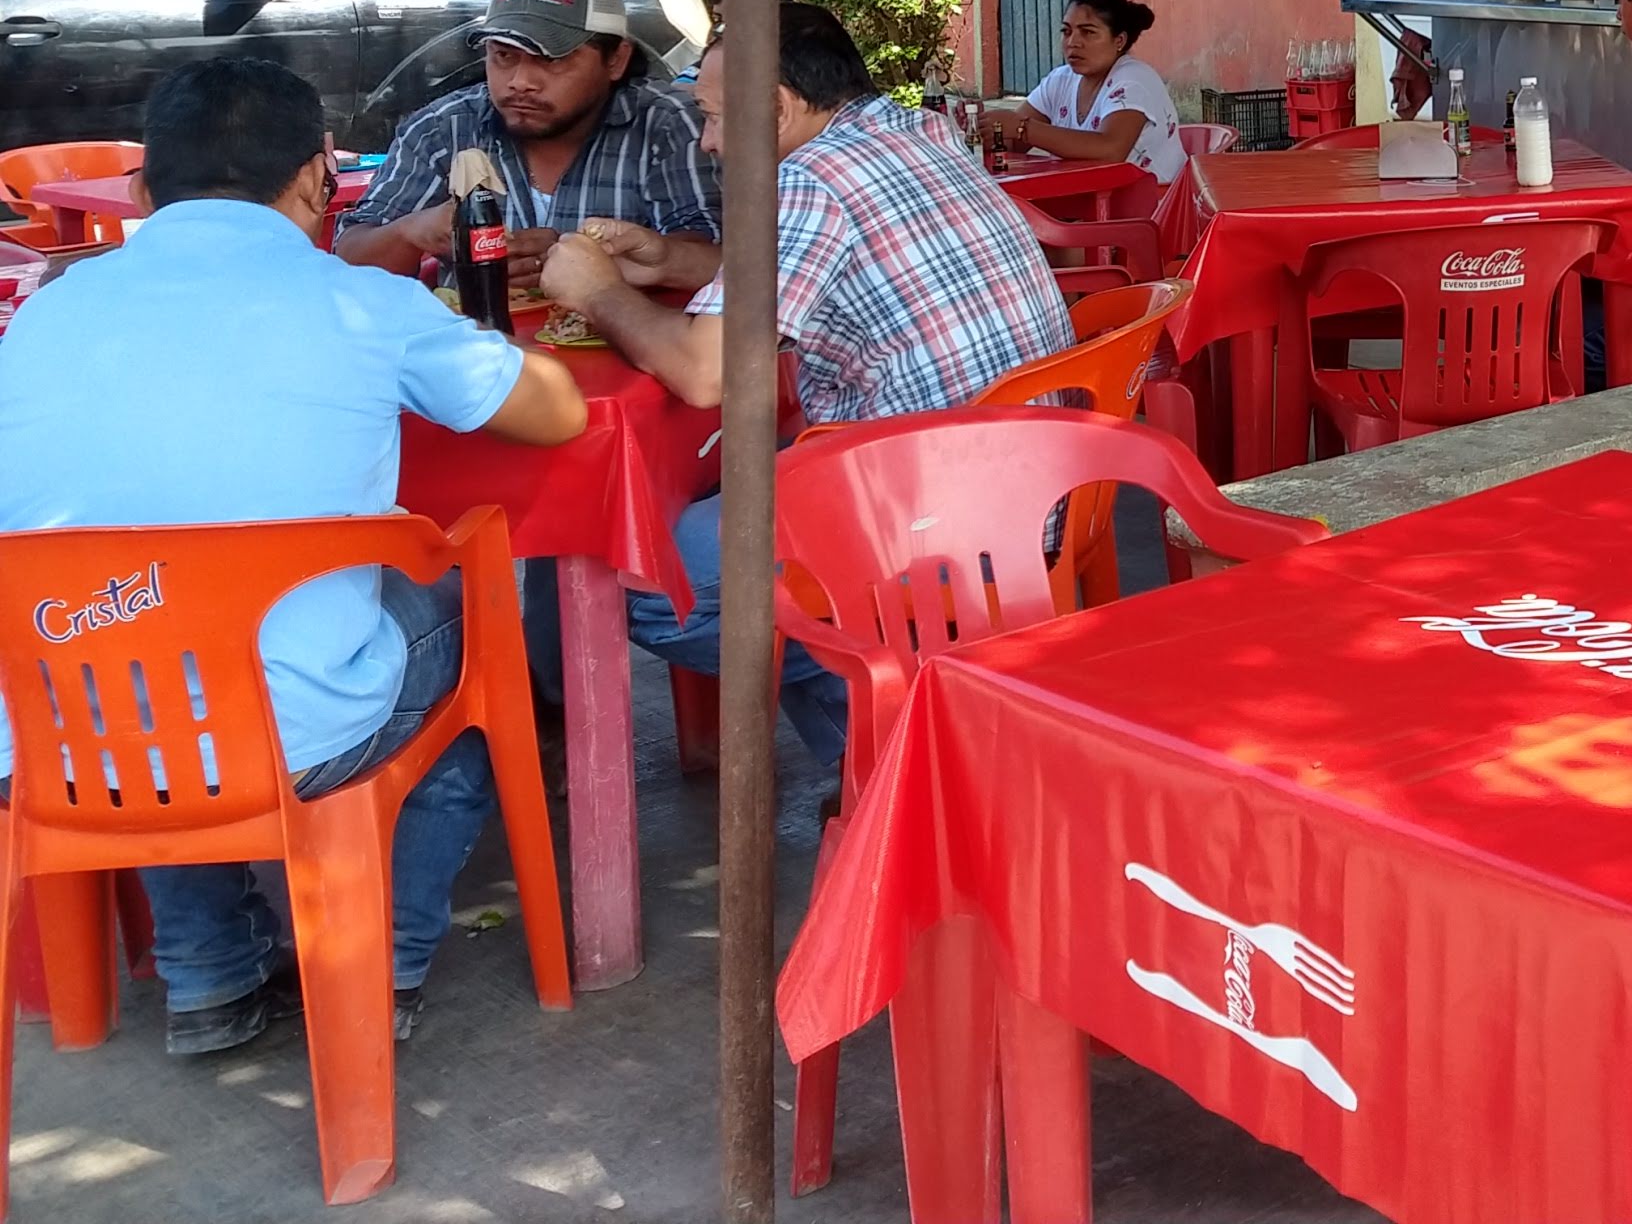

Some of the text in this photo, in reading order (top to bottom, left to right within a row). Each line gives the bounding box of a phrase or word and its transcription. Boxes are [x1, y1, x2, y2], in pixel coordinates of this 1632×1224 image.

[1441, 248, 1526, 276] Coca-Cola
[1443, 276, 1522, 289] EVENTOS ESPECIALES
[33, 562, 163, 644] Cristal
